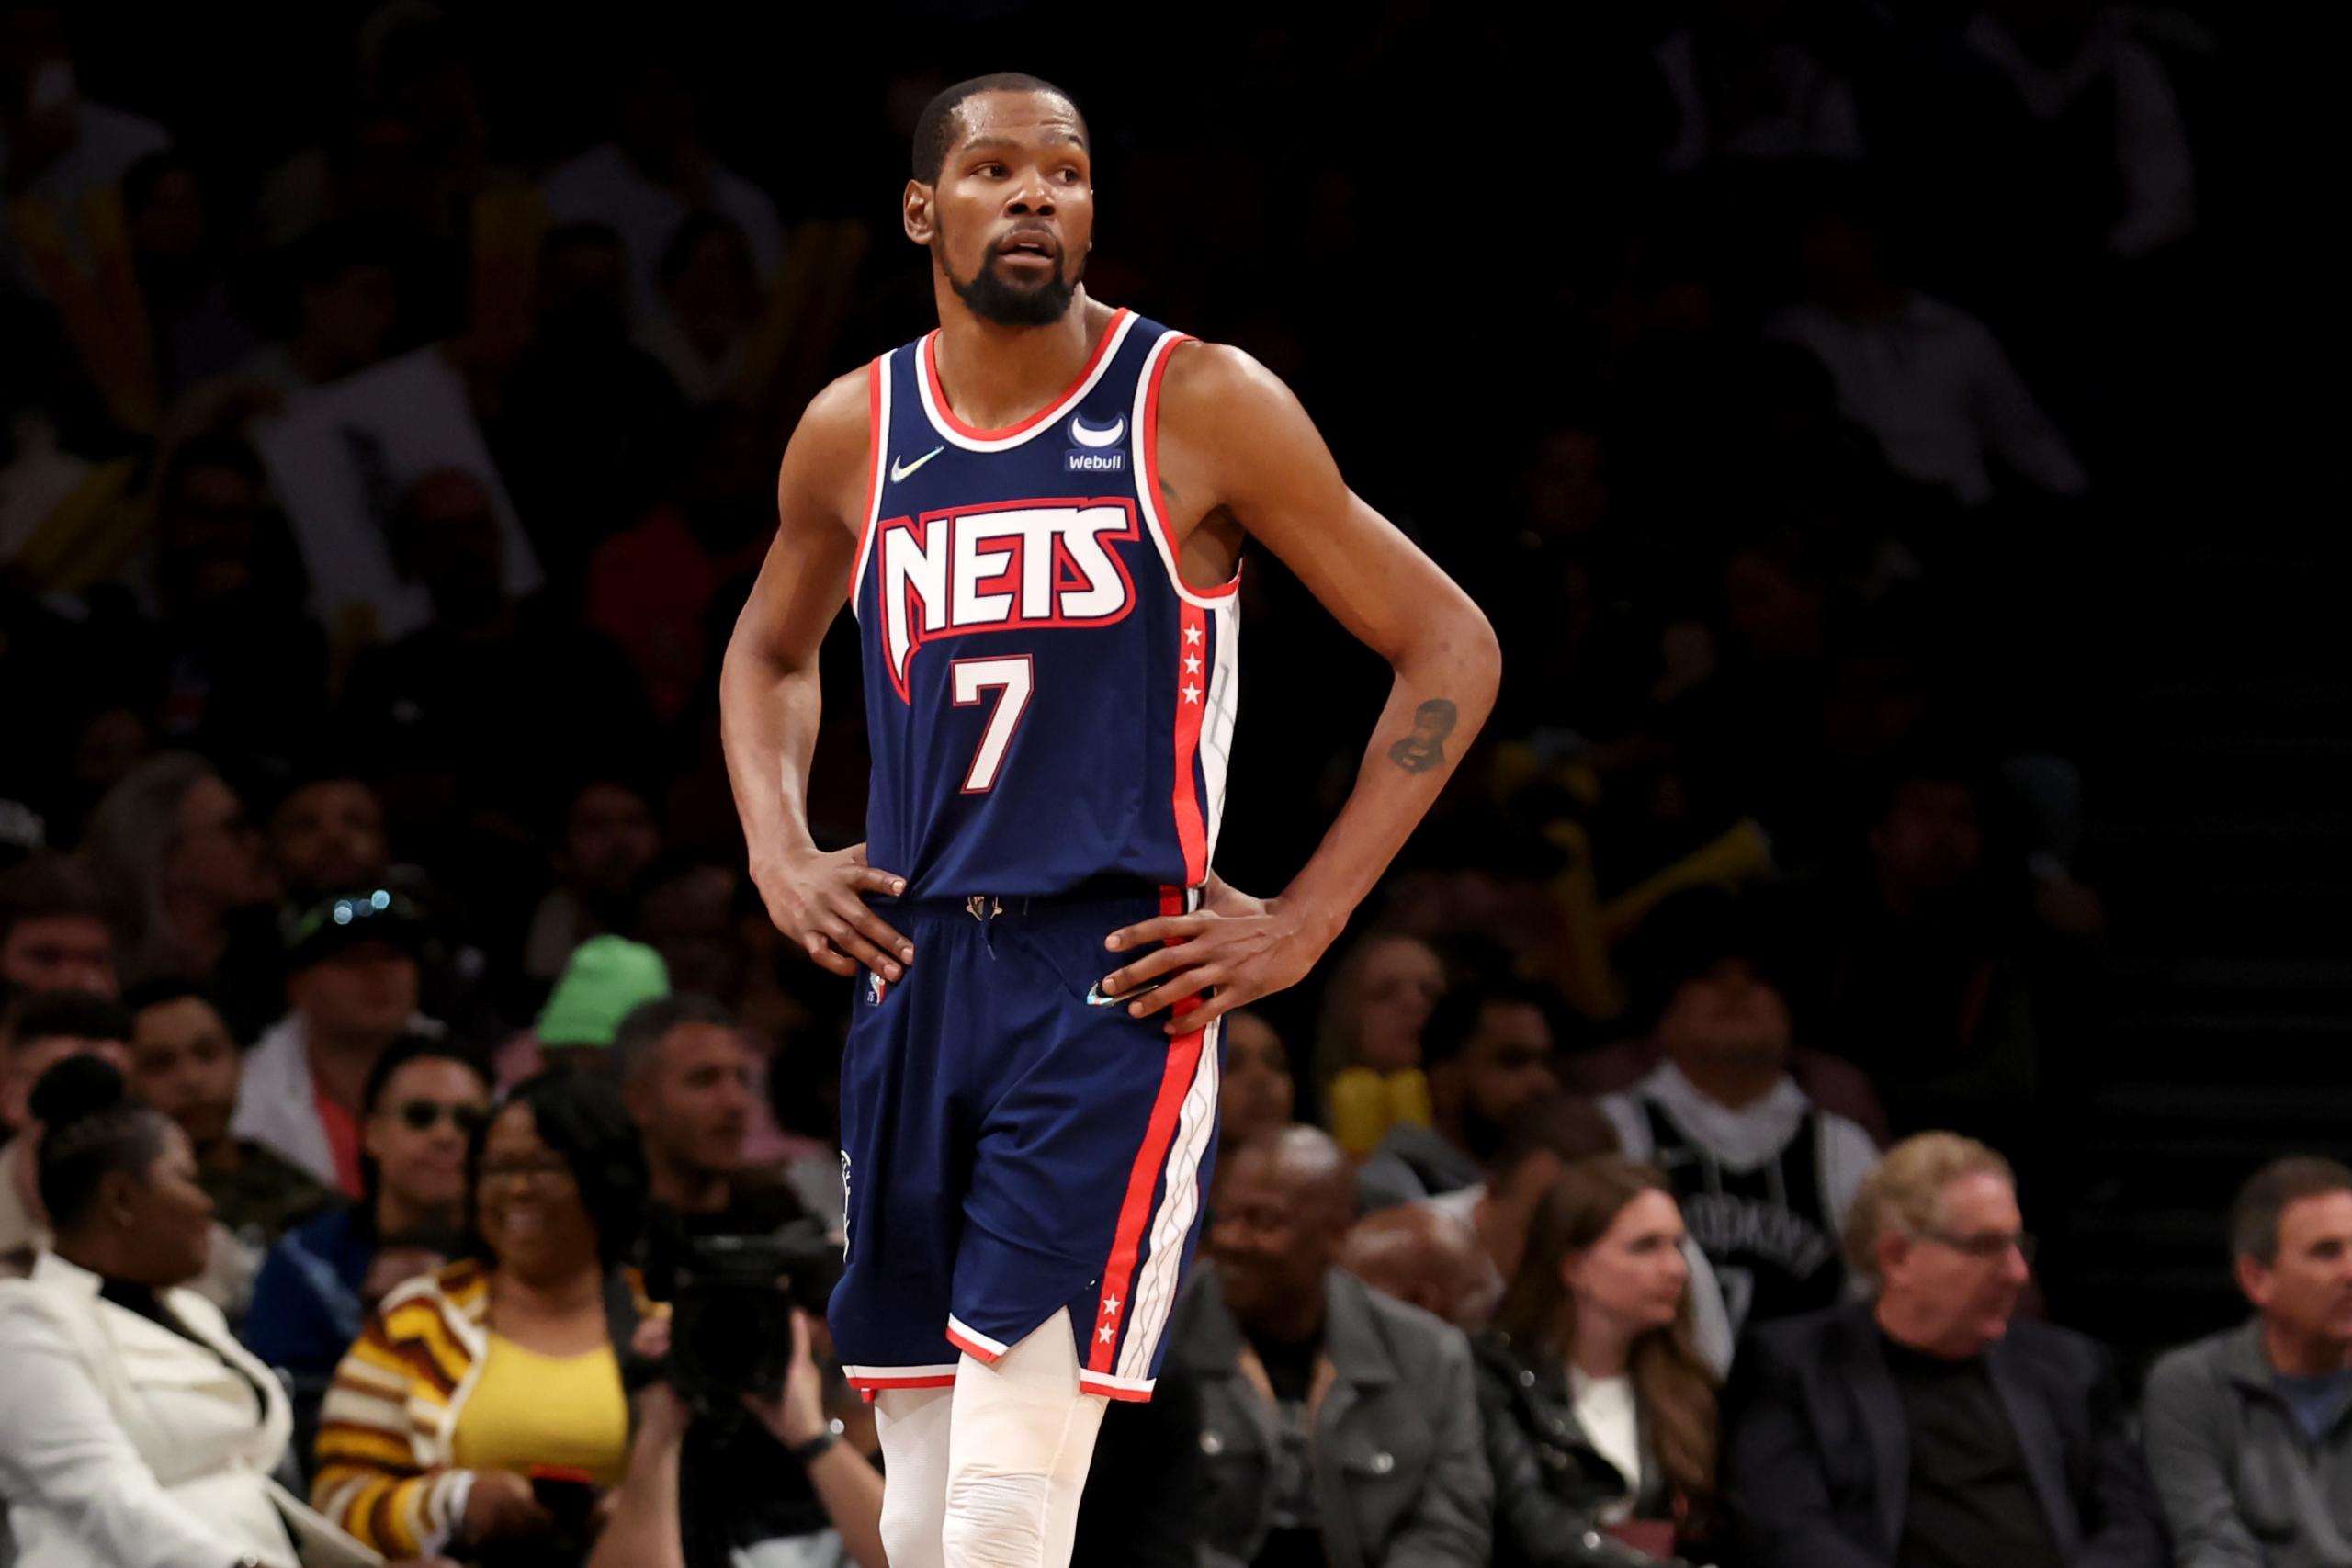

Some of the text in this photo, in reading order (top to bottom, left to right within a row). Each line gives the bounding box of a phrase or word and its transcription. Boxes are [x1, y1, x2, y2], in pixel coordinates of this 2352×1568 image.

[1069, 455, 1122, 469] Webull
[879, 497, 1140, 705] NETS
[950, 653, 1035, 794] 7
